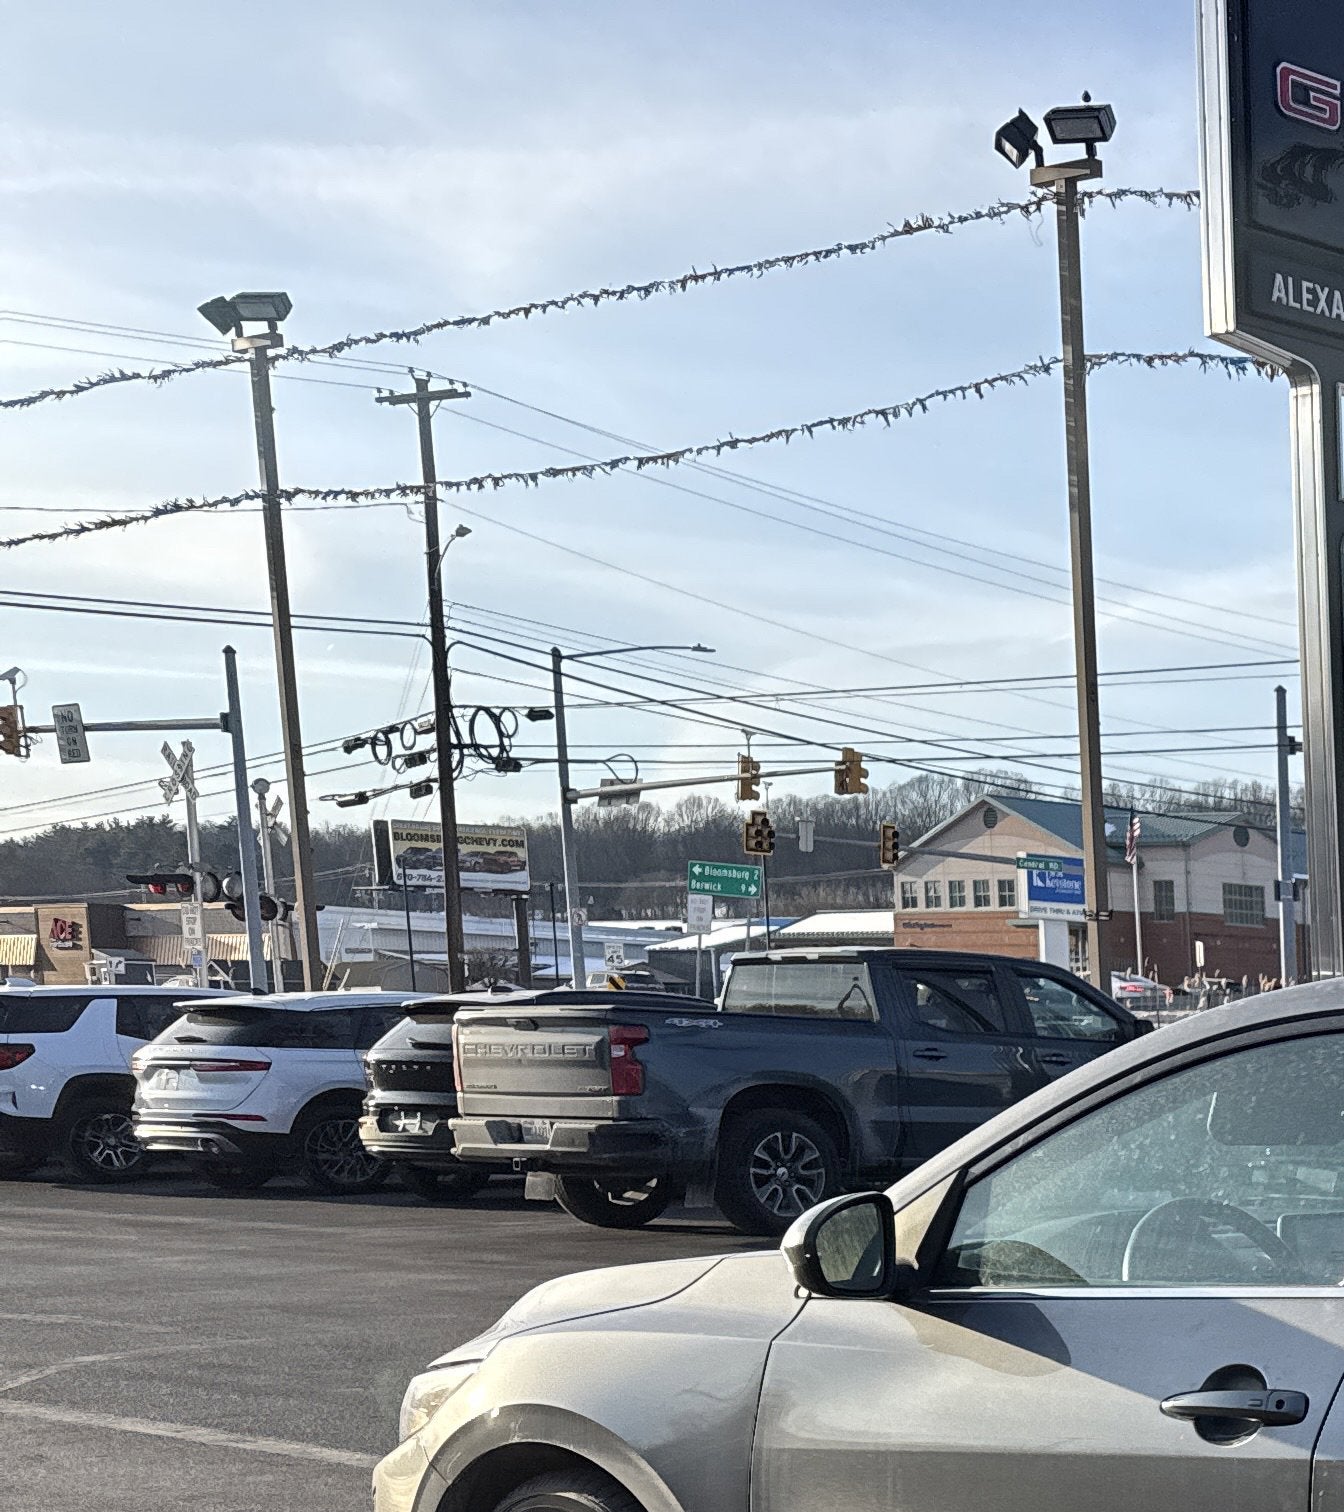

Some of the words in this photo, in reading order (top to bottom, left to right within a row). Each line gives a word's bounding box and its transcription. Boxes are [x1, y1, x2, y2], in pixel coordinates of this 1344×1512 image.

[61, 710, 73, 722] NO
[393, 832, 525, 848] BLOOMSBGCHEVY.COM
[704, 865, 750, 880] Bloomsburg
[753, 869, 759, 880] 2
[691, 879, 721, 891] Berwick
[740, 883, 746, 893] 9
[49, 918, 73, 940] ACE
[608, 954, 624, 964] 45
[463, 1044, 595, 1058] CHEVROLET
